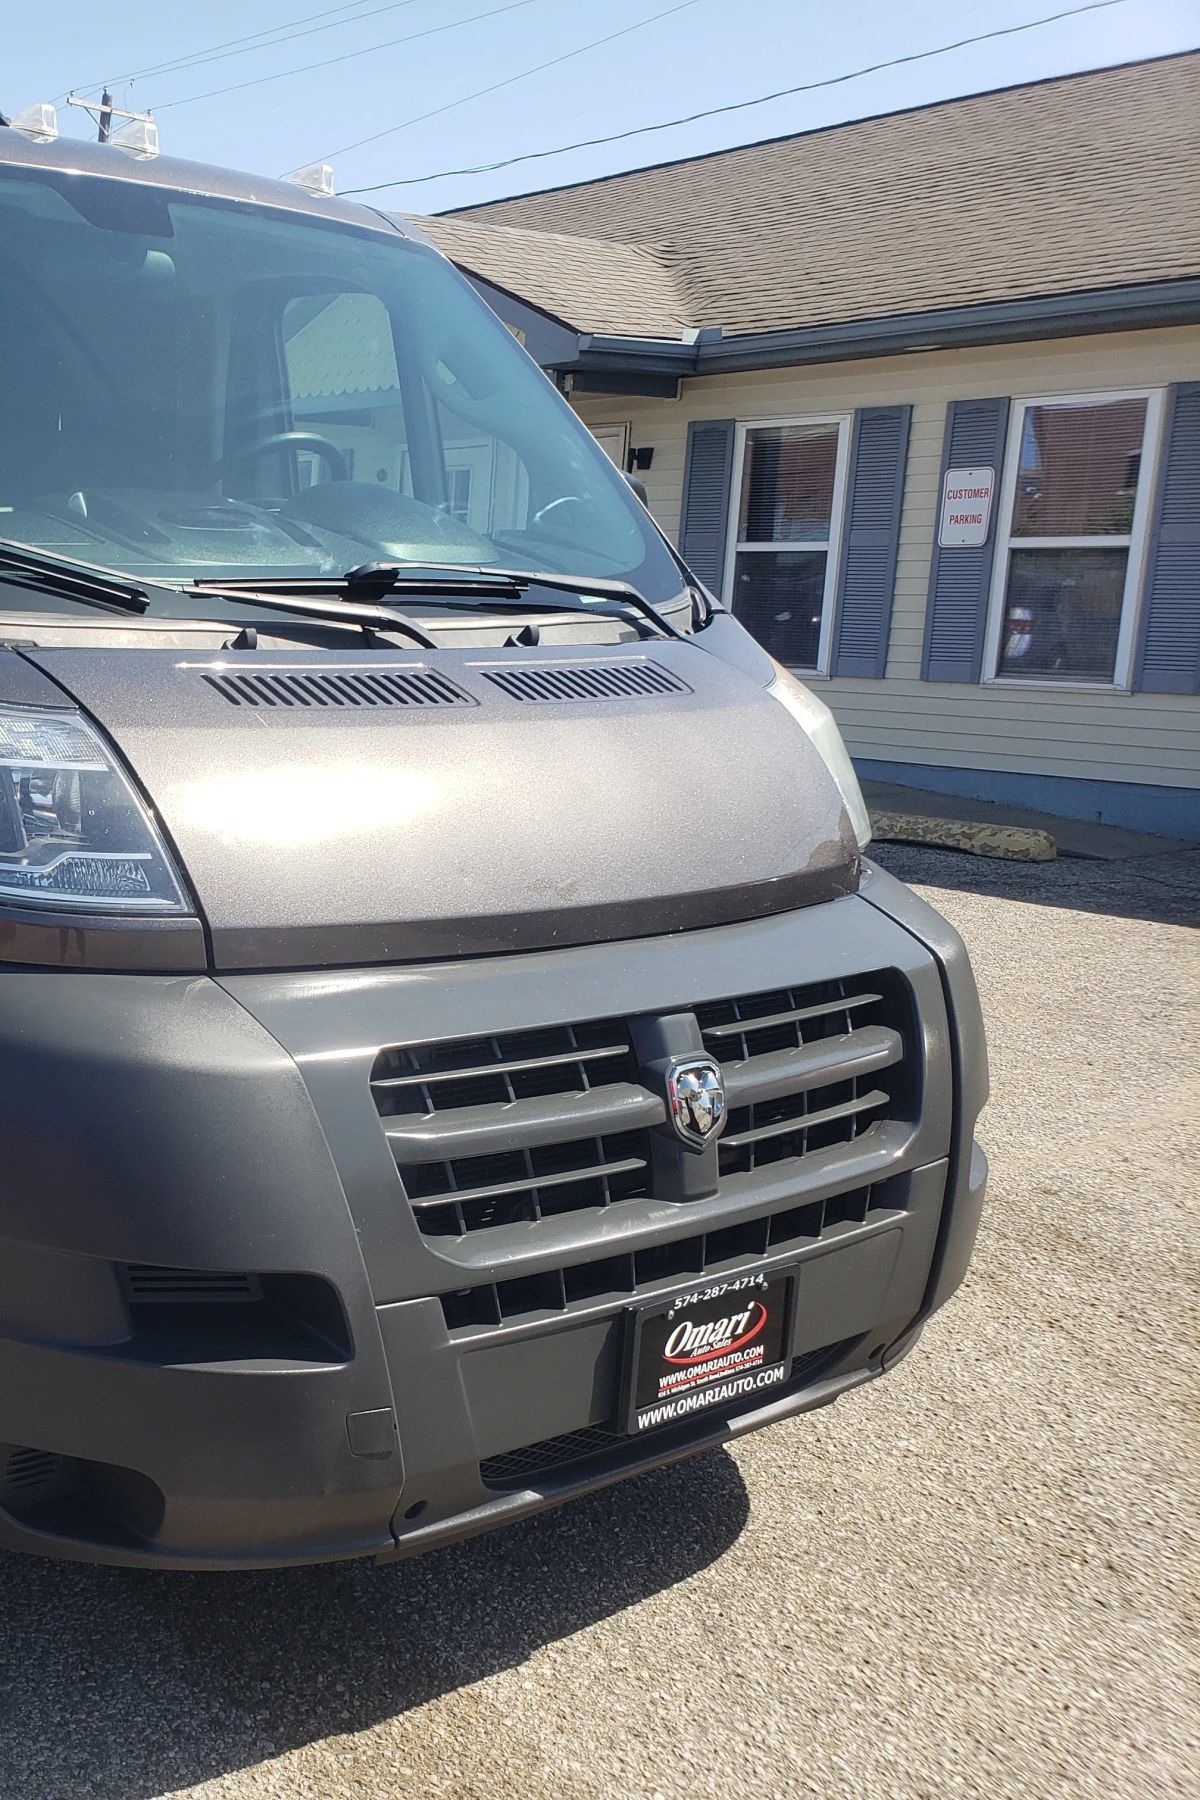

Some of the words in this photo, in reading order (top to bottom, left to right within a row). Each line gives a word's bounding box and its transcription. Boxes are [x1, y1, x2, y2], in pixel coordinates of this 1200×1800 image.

[947, 488, 990, 500] CUSTOMER
[949, 514, 982, 525] PARKING
[673, 1273, 764, 1310] 574-287-4714
[664, 1301, 755, 1358] Omari
[690, 1345, 711, 1357] Auto
[711, 1337, 732, 1351] Sales
[658, 1345, 764, 1388] WWW.OMARIAUTO.COM
[637, 1367, 784, 1429] WWW.OMARIAUTO.COM
